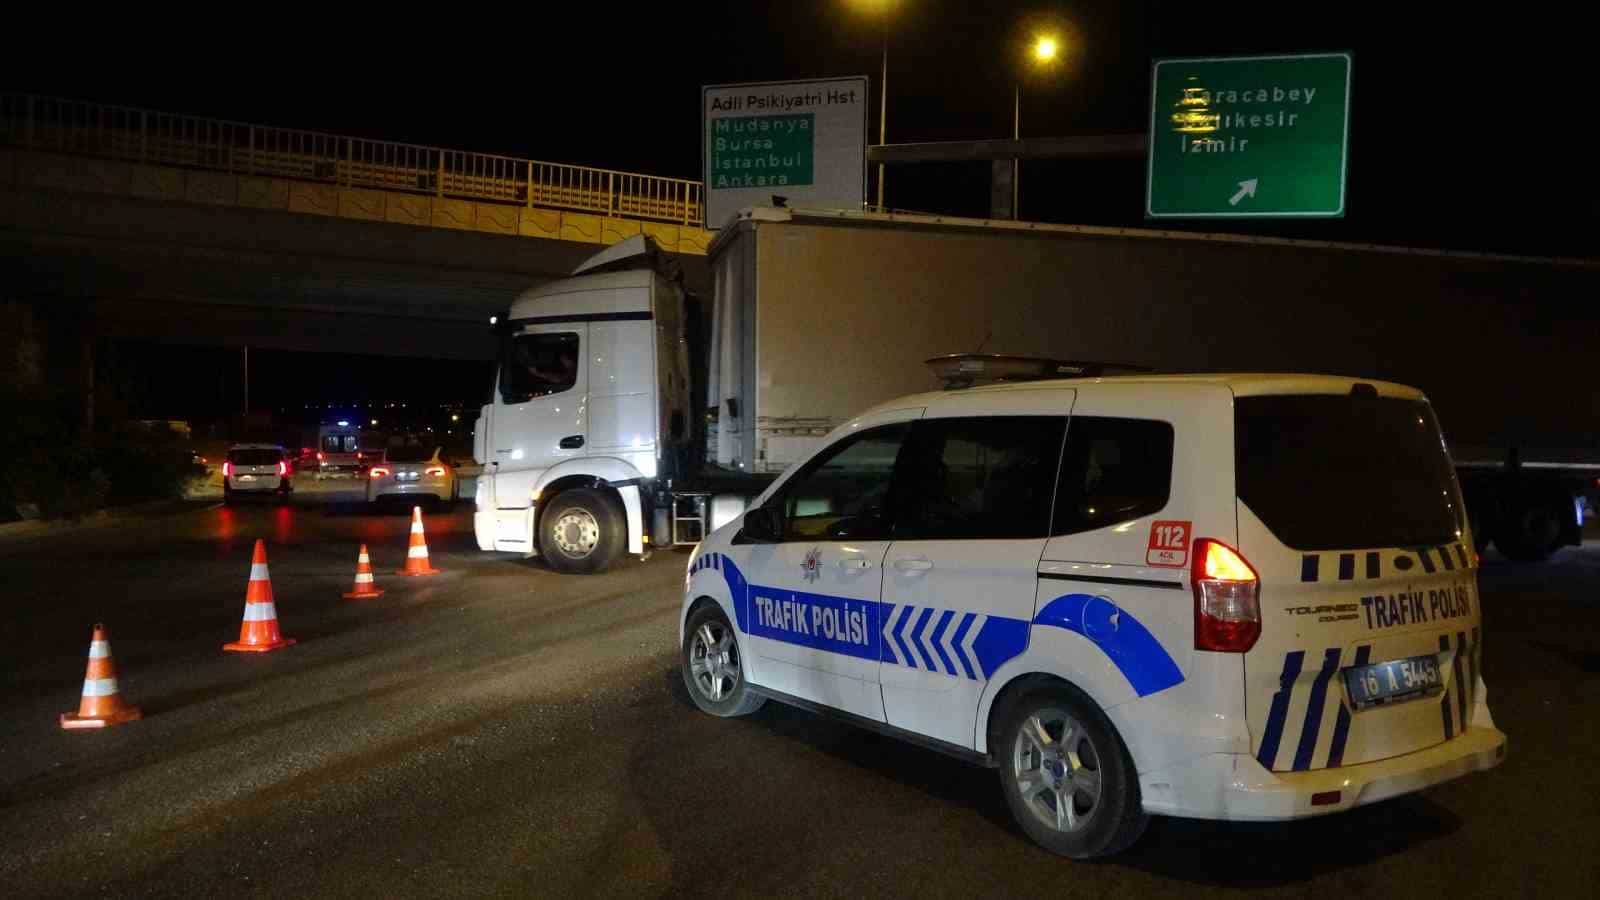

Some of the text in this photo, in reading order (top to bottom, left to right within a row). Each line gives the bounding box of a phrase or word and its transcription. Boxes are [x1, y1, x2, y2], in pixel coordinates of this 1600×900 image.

[711, 89, 855, 111] Adli Psikiyatri Hst
[715, 118, 809, 134] Mudanya
[716, 136, 774, 151] Bursa
[715, 152, 801, 169] İstanbul
[717, 172, 789, 188] Ankara
[1156, 526, 1185, 547] 112
[1360, 584, 1429, 630] TRAFİK
[755, 593, 869, 646] TRAFİK POLİSİ
[1360, 668, 1379, 698] 16
[1386, 664, 1401, 691] A
